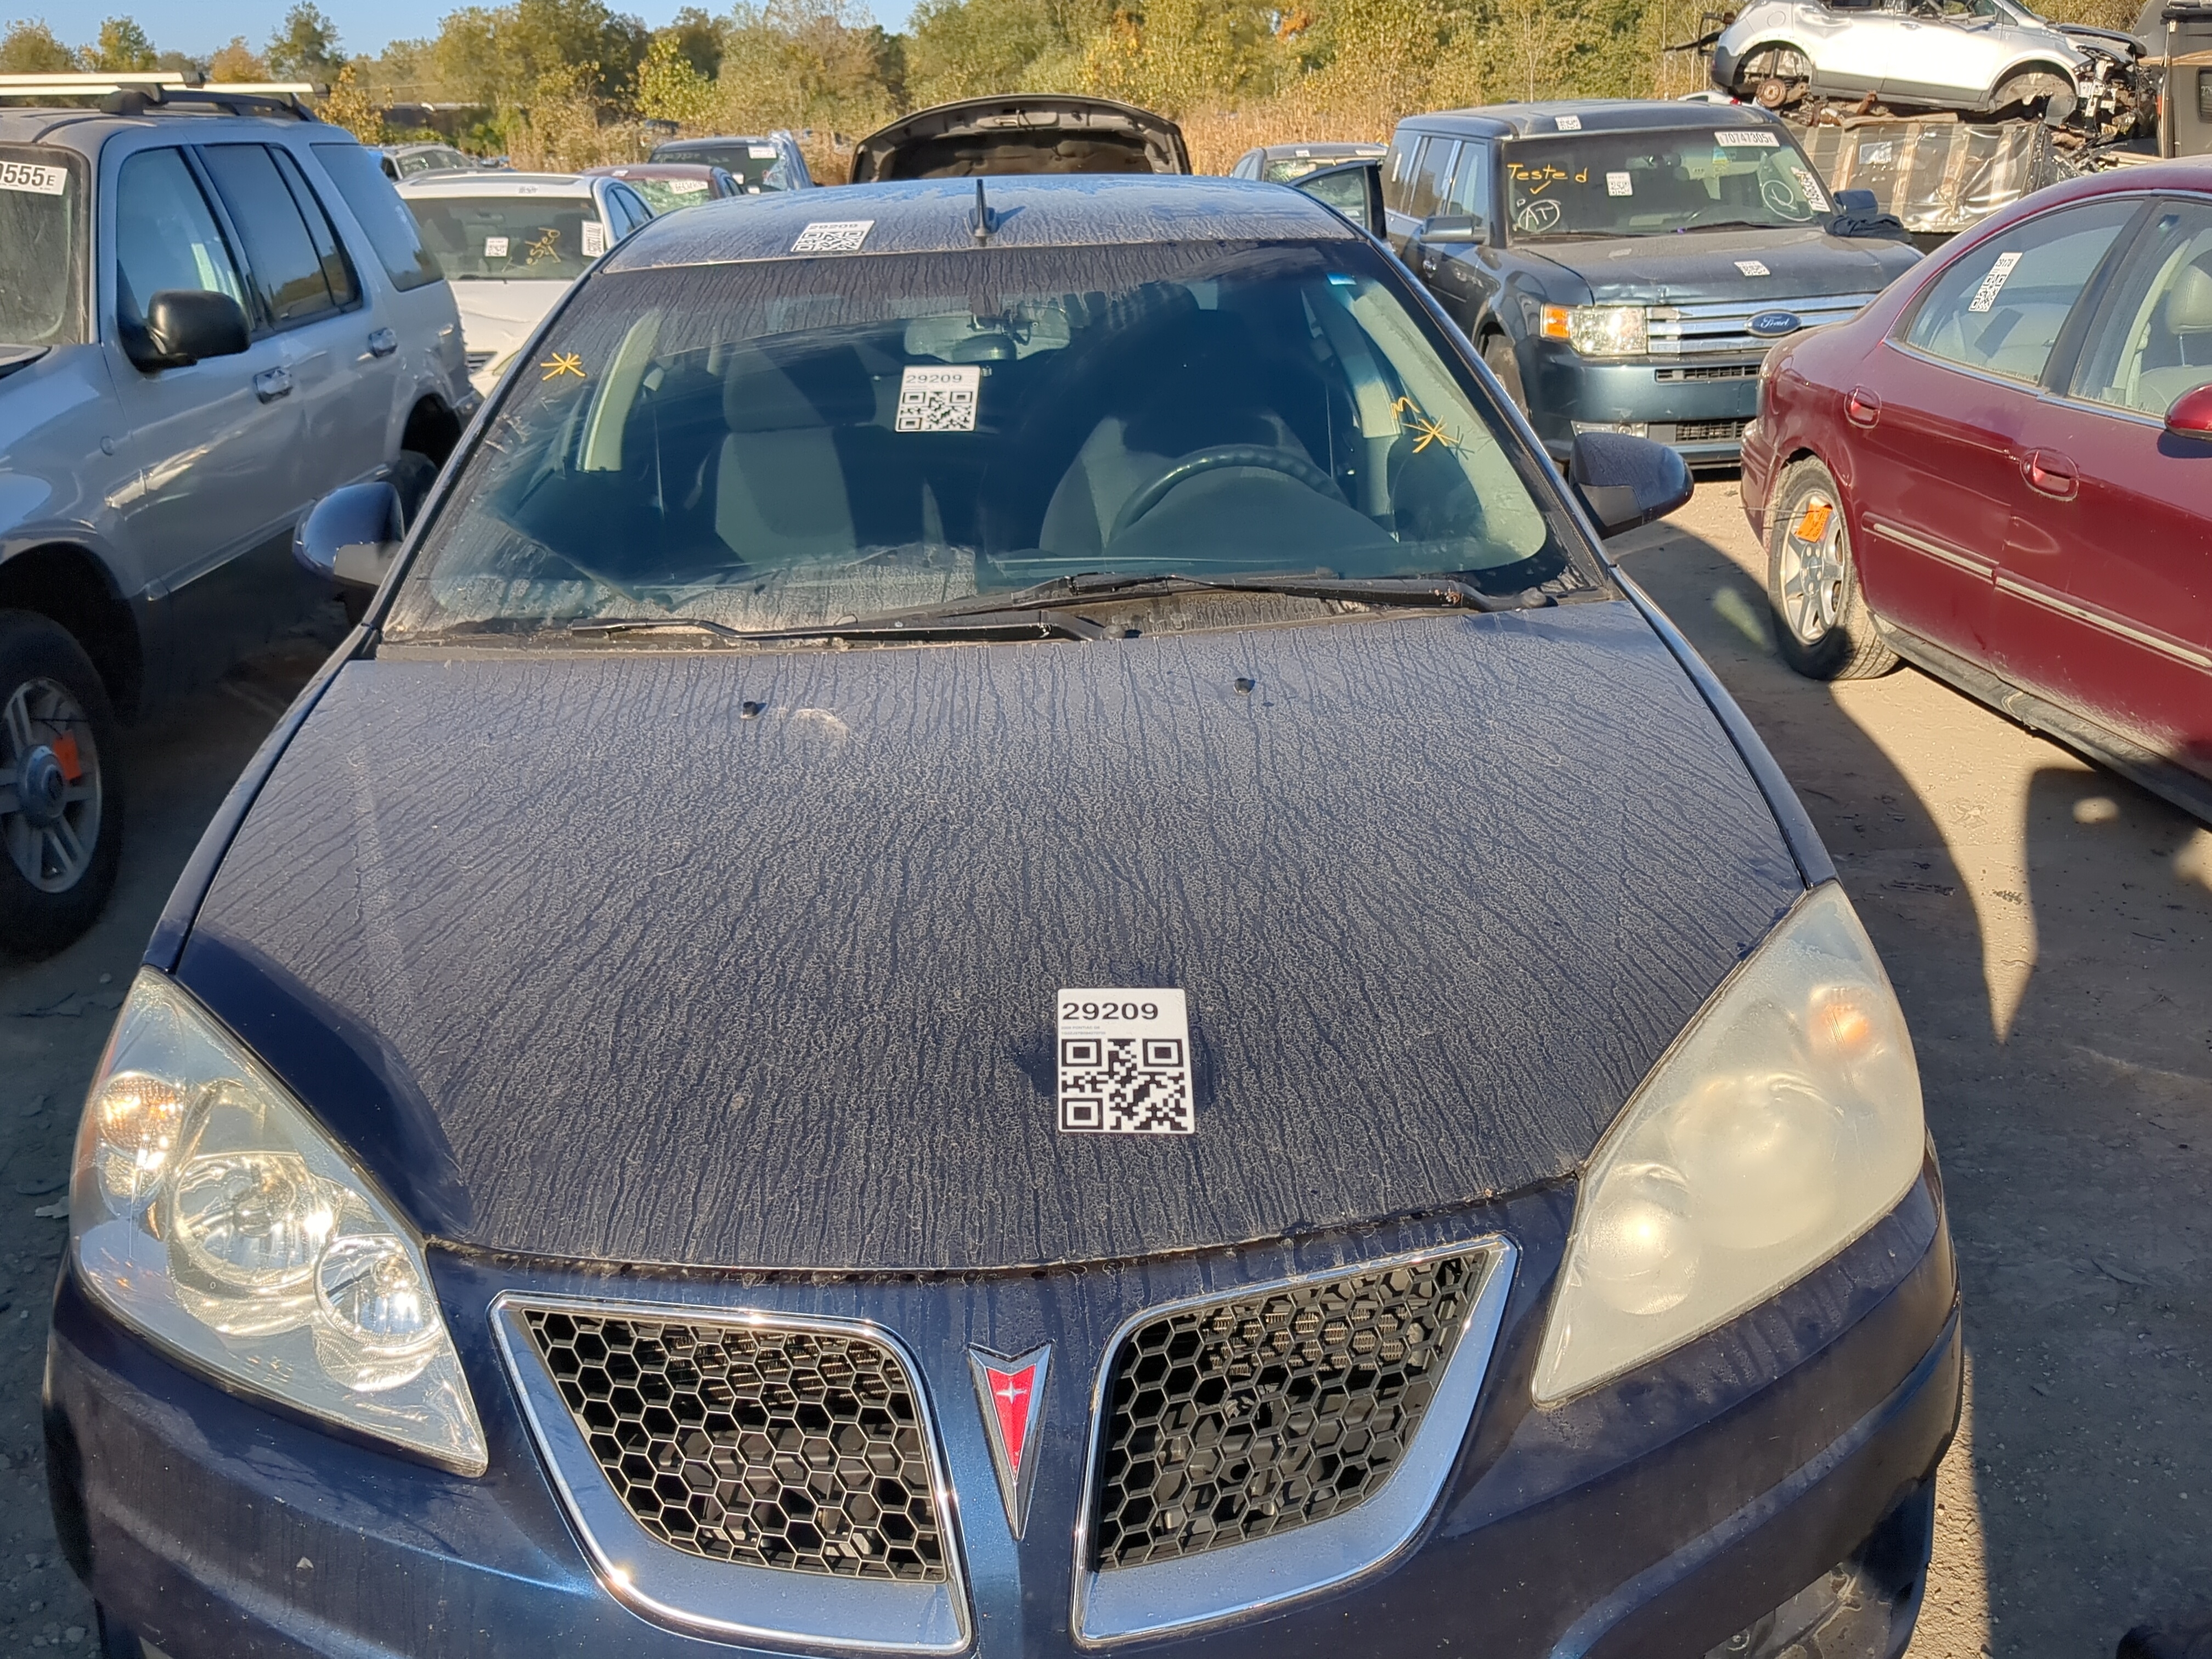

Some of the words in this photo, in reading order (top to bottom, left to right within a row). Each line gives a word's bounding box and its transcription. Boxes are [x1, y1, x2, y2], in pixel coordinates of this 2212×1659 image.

[0, 163, 55, 187] 555E
[1760, 315, 1790, 328] Ford
[906, 375, 962, 383] 29209
[1062, 1002, 1159, 1020] 29209
